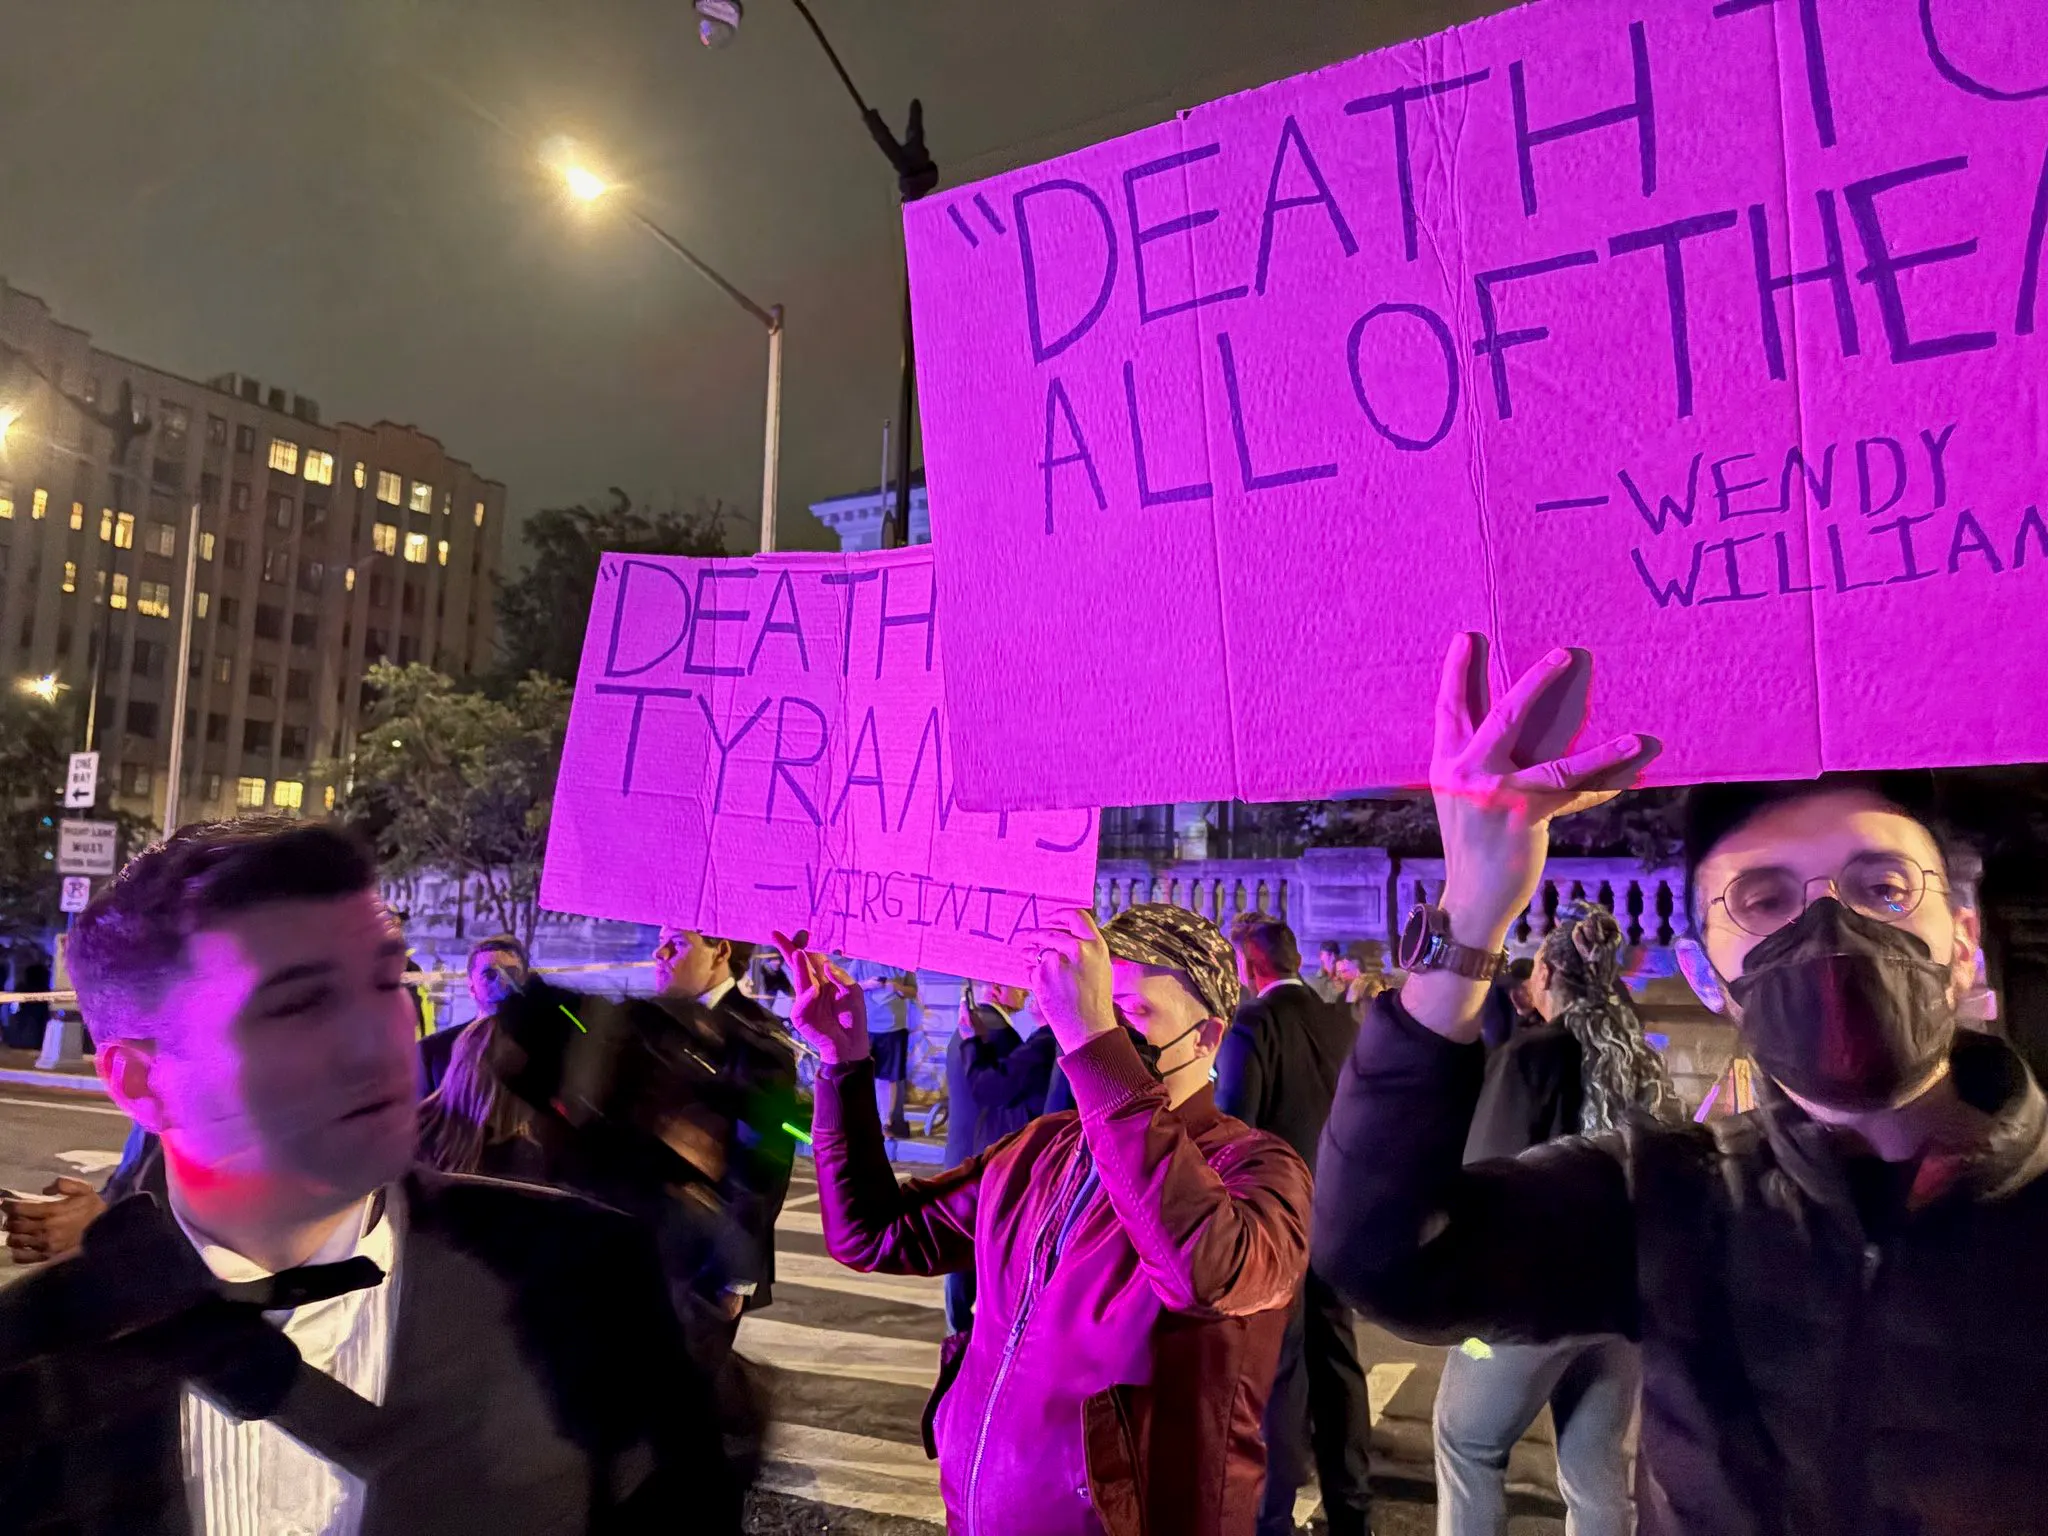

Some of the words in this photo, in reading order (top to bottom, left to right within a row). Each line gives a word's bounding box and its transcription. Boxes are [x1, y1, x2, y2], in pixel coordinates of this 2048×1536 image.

[1037, 332, 1338, 535] ALL
[1347, 250, 1598, 451] OF
[1608, 155, 2048, 420] THE
